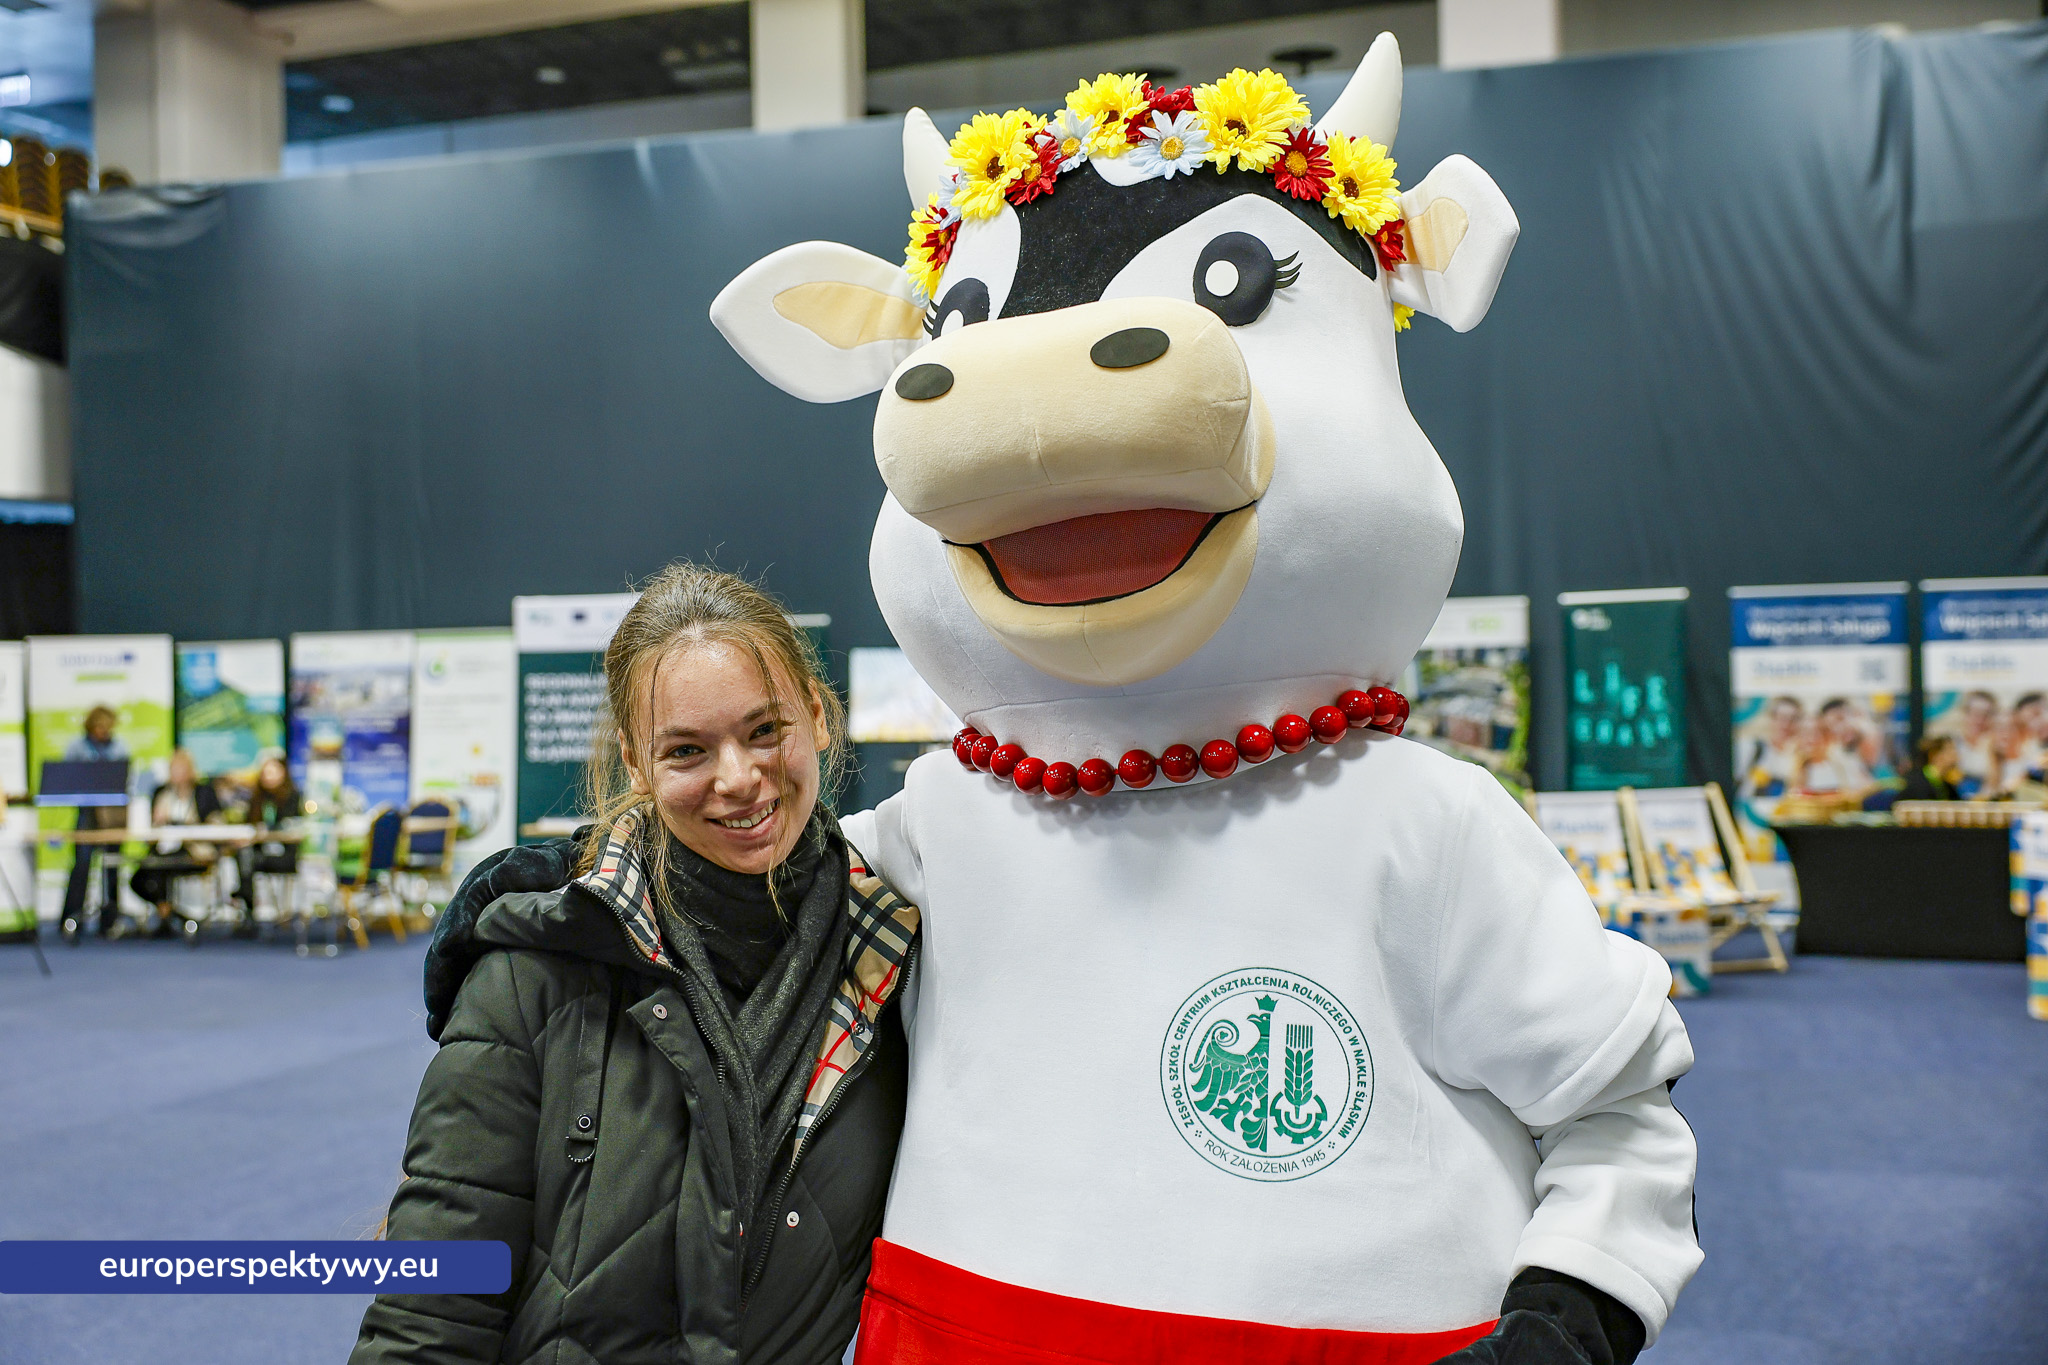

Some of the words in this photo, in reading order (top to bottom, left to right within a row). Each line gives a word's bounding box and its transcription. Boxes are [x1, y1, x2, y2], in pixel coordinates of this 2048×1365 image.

[1211, 976, 1290, 998] KSZTAŁCENIA
[1177, 994, 1211, 1041] CENTRUM
[1292, 983, 1352, 1035] ROLNICZEGO
[1349, 1036, 1358, 1046] W
[1169, 1045, 1181, 1082] SZKÓŁ
[1353, 1048, 1367, 1088] NAKLE
[1170, 1084, 1195, 1129] ZESPÓŁ
[1338, 1090, 1367, 1139] ŚLĄSKIM
[1204, 1138, 1228, 1161] ROK
[1230, 1155, 1300, 1174] ZAŁOŻENIA
[1301, 1150, 1327, 1168] 1945
